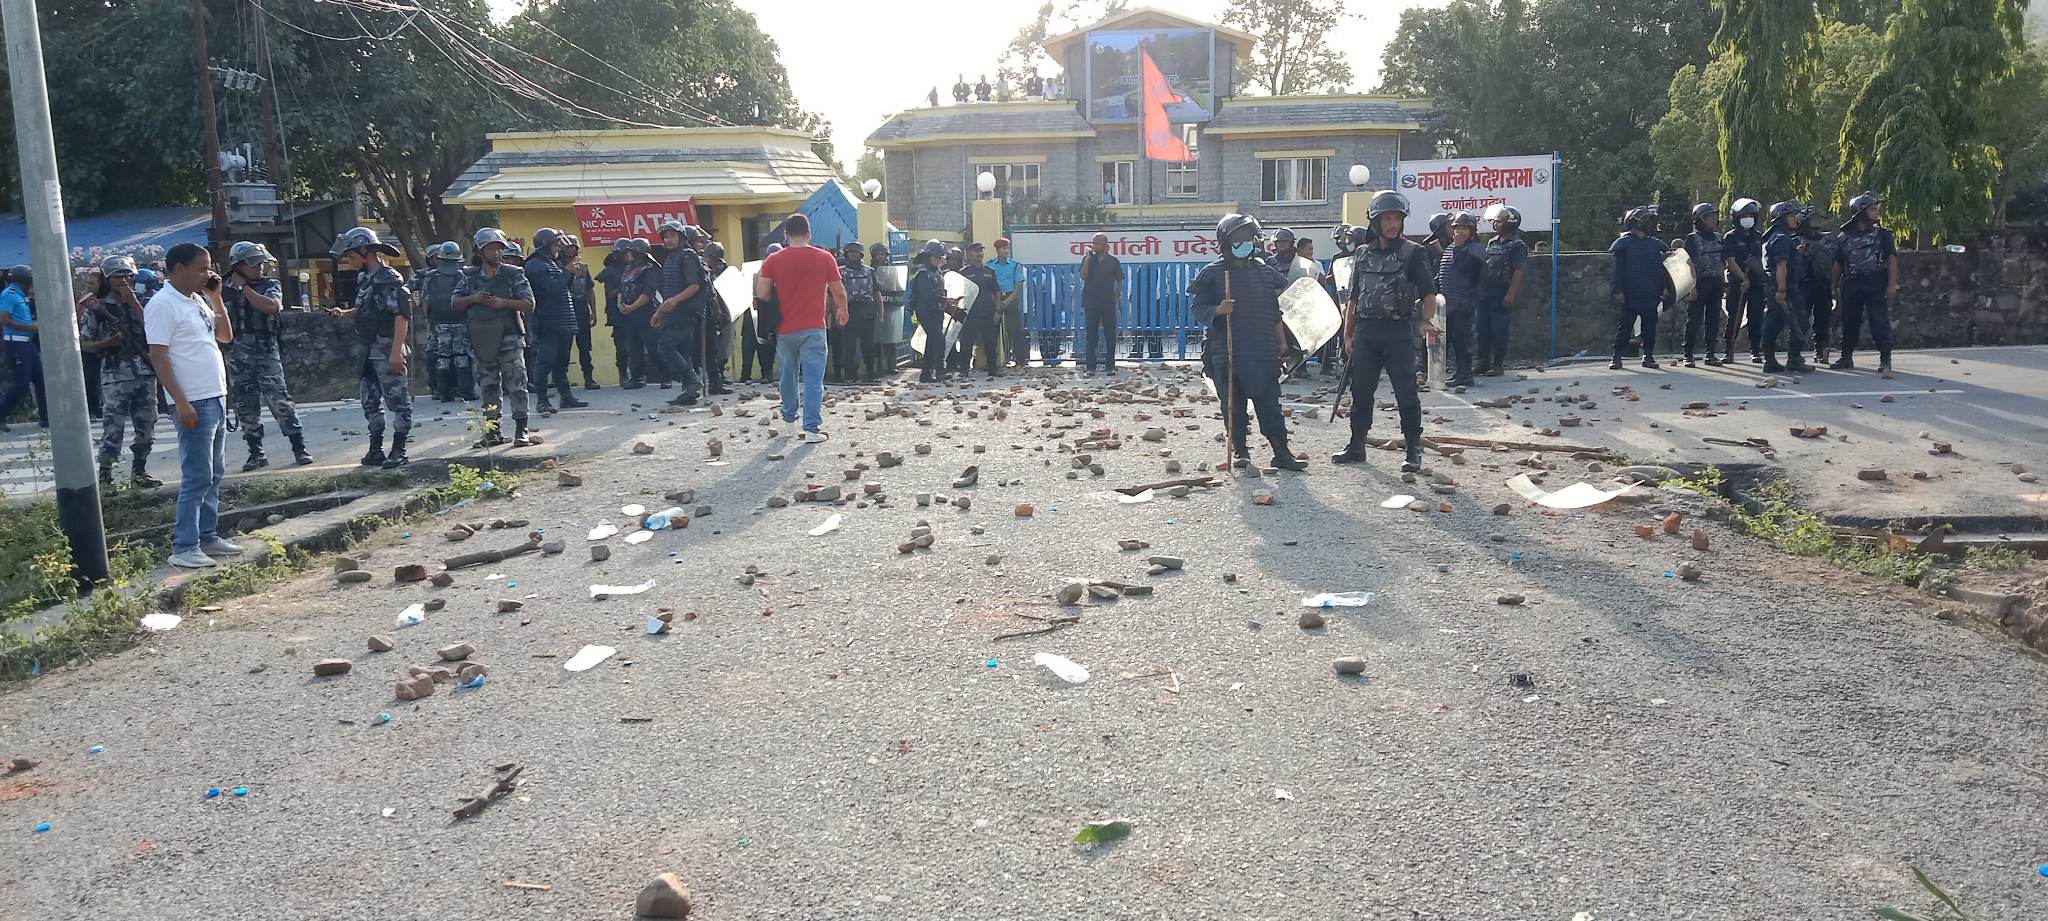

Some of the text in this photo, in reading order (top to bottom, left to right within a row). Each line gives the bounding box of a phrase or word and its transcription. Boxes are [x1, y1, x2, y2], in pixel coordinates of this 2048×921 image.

[1418, 166, 1469, 191] कर्णाली
[581, 219, 624, 228] NIC ASIA
